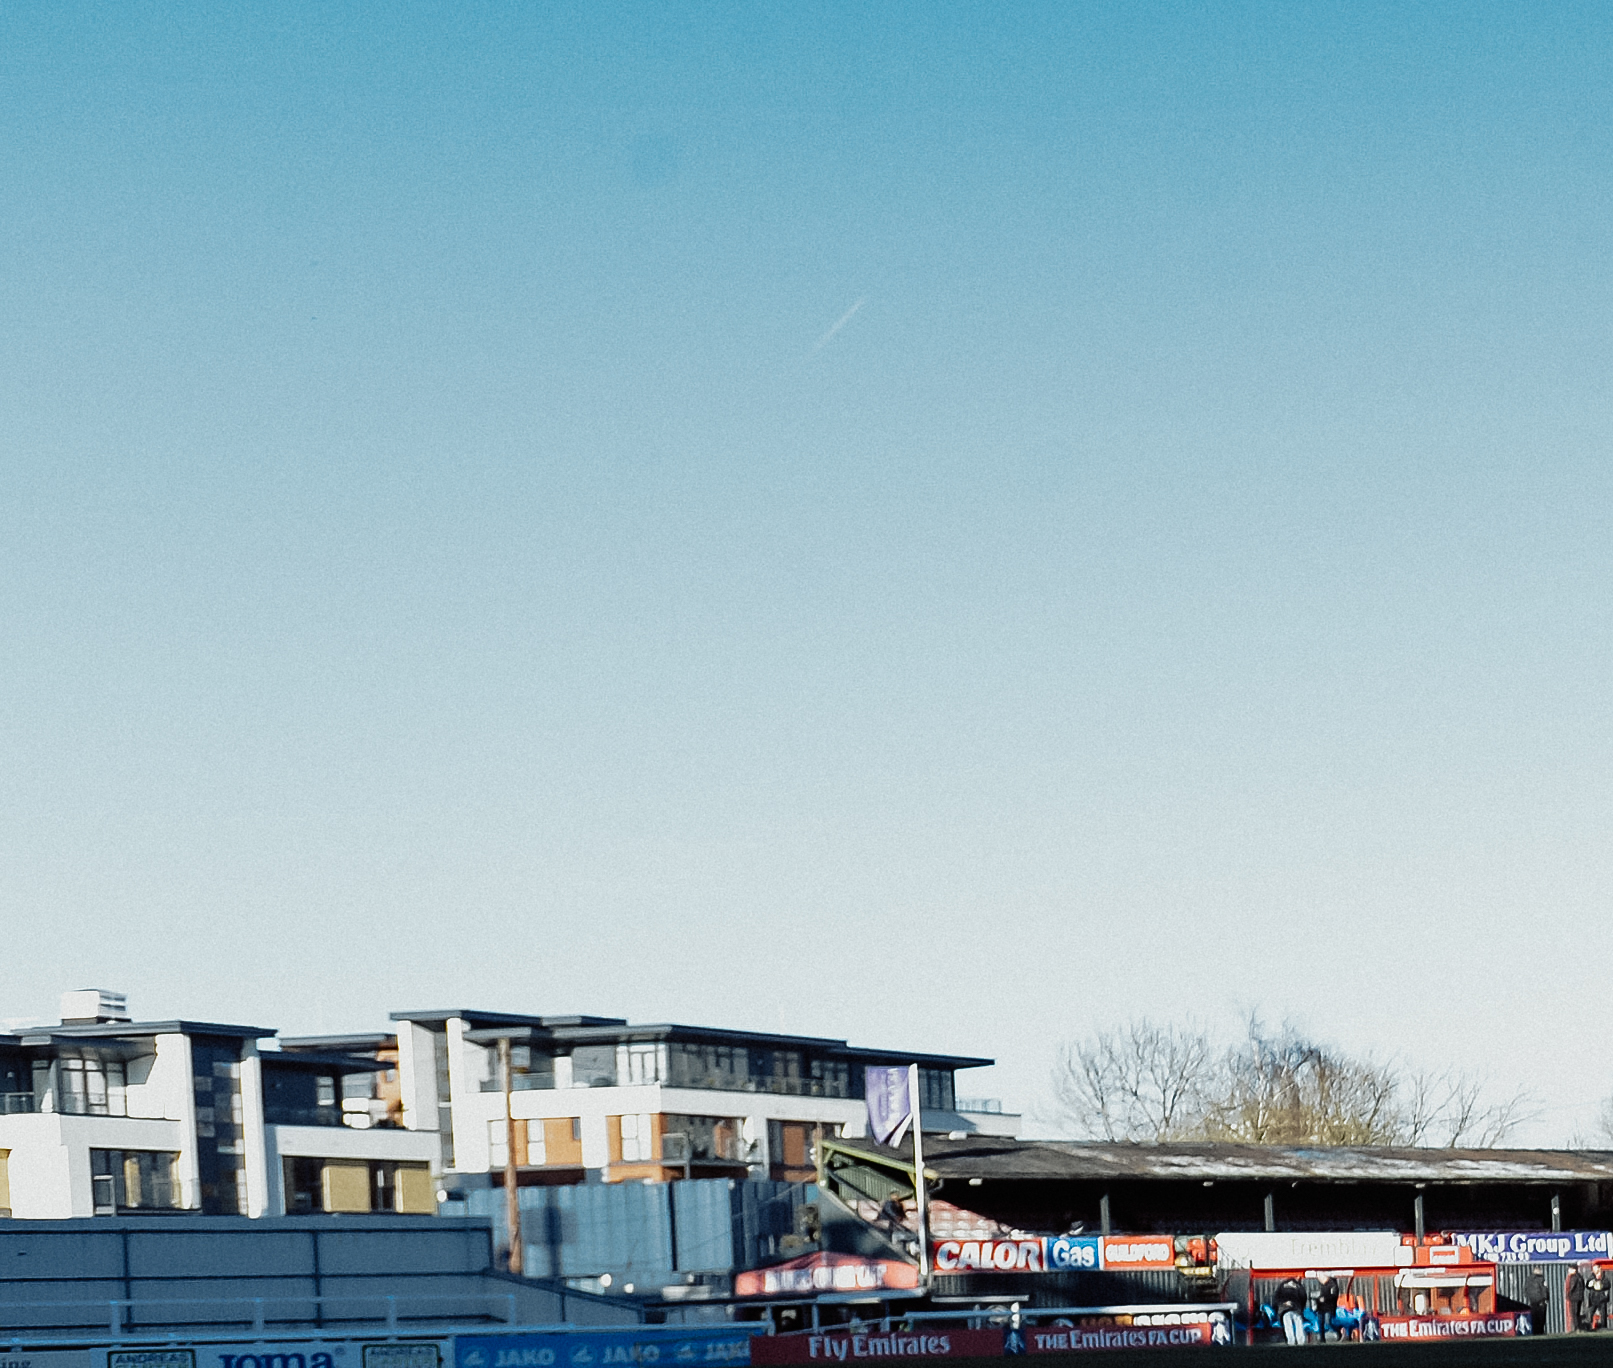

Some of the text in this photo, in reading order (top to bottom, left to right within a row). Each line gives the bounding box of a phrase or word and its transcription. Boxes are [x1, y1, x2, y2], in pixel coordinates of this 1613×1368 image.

[937, 1240, 1040, 1272] CALOR
[1053, 1239, 1095, 1268] Gas
[1510, 1232, 1571, 1257] Group
[1575, 1232, 1606, 1253] Ltd
[1035, 1328, 1202, 1350] THE Emirates FA CUP
[1381, 1318, 1513, 1338] THE Emirates FA CUP
[495, 1348, 556, 1367] JAKO
[808, 1333, 951, 1361] Fly Emirates
